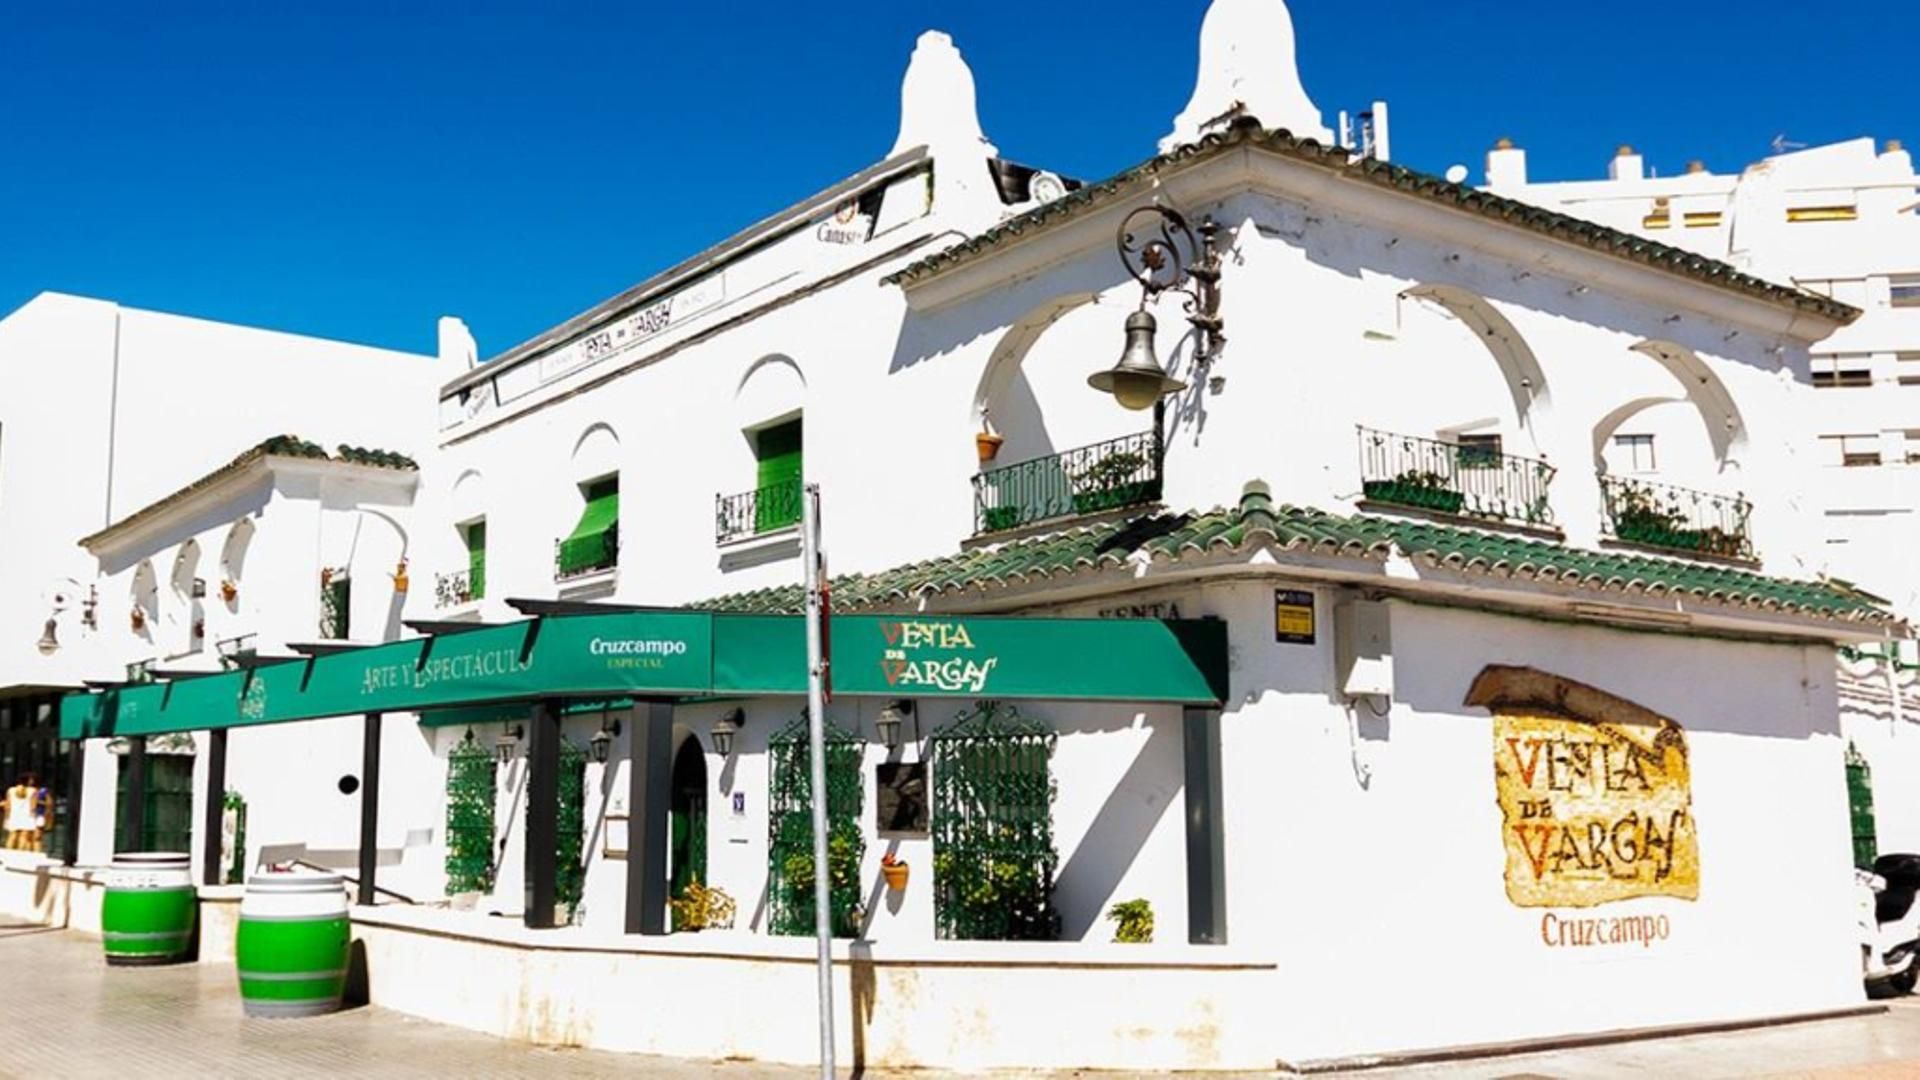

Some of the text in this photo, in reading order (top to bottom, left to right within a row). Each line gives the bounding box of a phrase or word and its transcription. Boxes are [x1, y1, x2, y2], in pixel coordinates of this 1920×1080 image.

[590, 637, 687, 656] Cruzcampo
[880, 621, 975, 649] VENTA
[607, 657, 664, 669] ESPECIAL
[884, 649, 906, 660] DE
[360, 665, 398, 695] ARTE
[413, 650, 533, 688] ESPECTÁCULO
[880, 657, 998, 692] VARGAS
[1505, 732, 1653, 793] VENTA
[1518, 798, 1553, 820] DE
[1512, 809, 1687, 883] VARGAS
[1541, 911, 1671, 949] Cruzcampo
